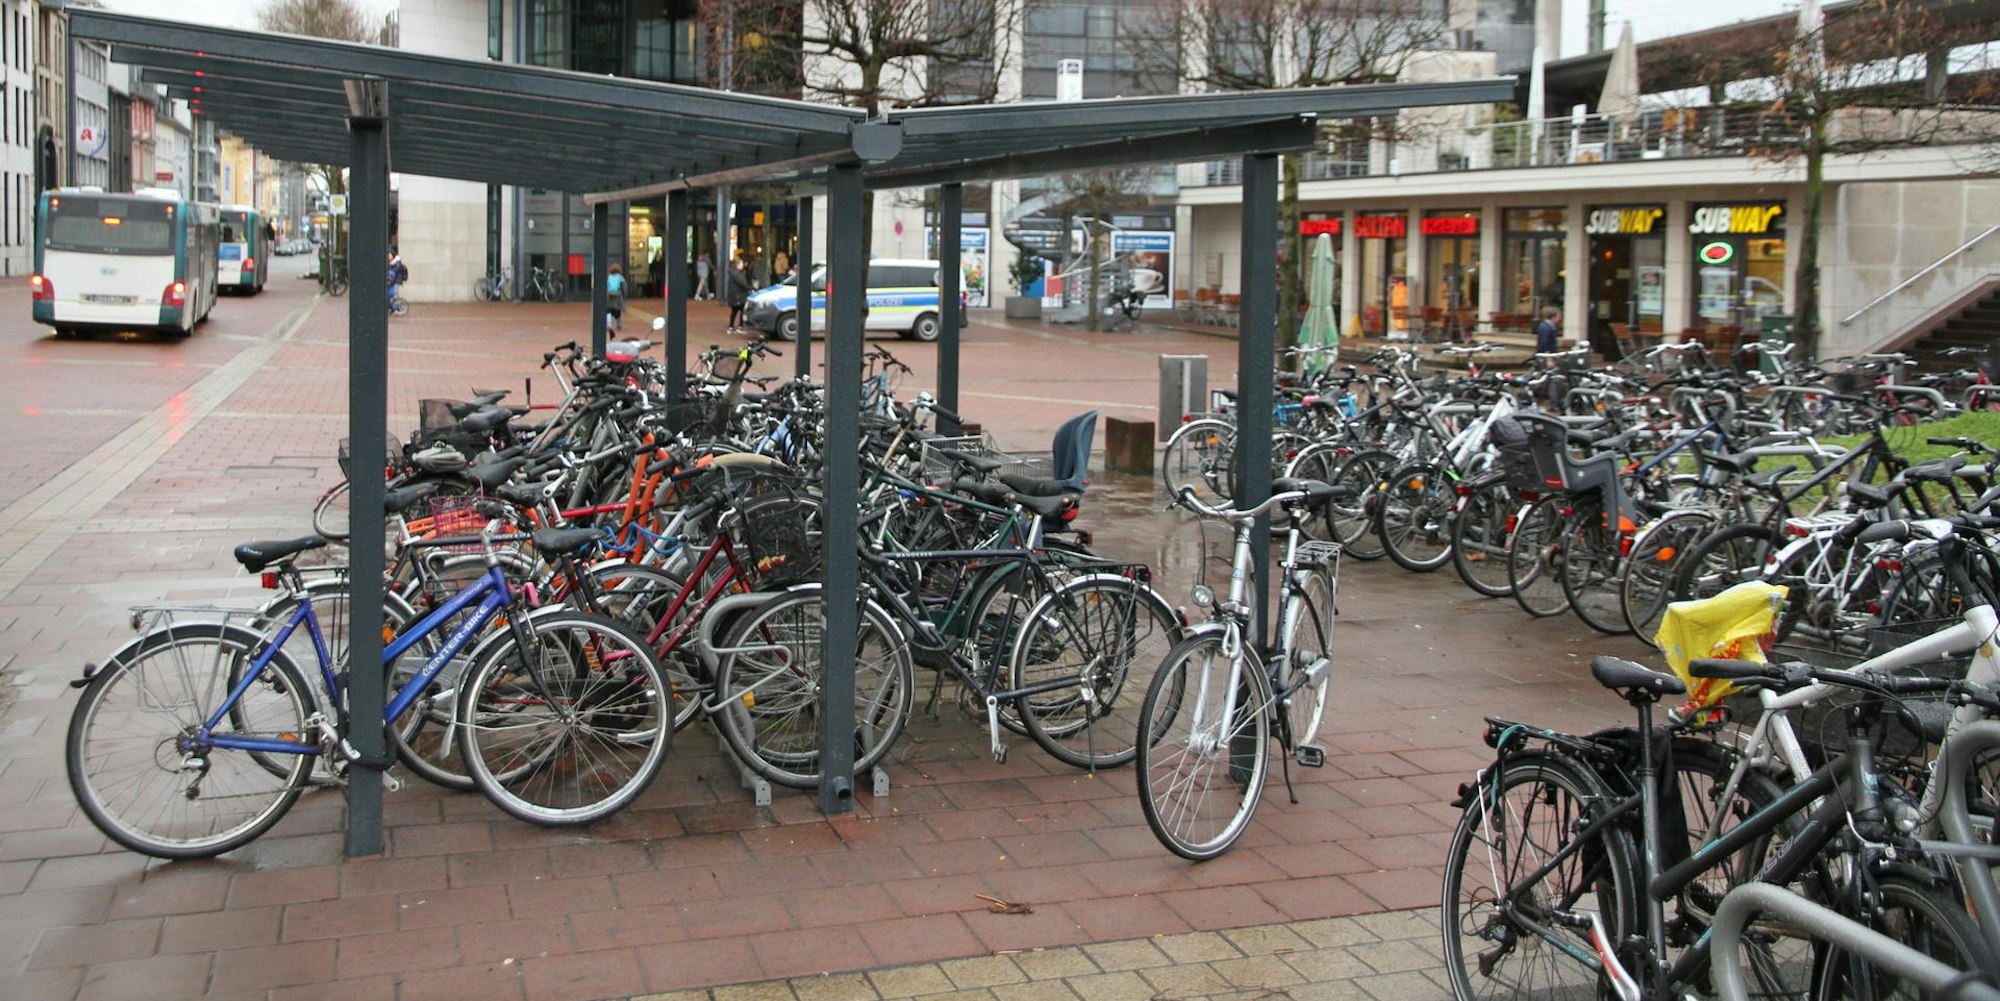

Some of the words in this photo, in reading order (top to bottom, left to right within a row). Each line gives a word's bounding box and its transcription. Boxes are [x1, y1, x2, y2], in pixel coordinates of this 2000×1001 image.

[1353, 216, 1406, 238] SULTAN
[1586, 208, 1664, 235] SUBWAY
[1689, 205, 1783, 235] SUBWAY
[868, 298, 903, 307] POLIZEI
